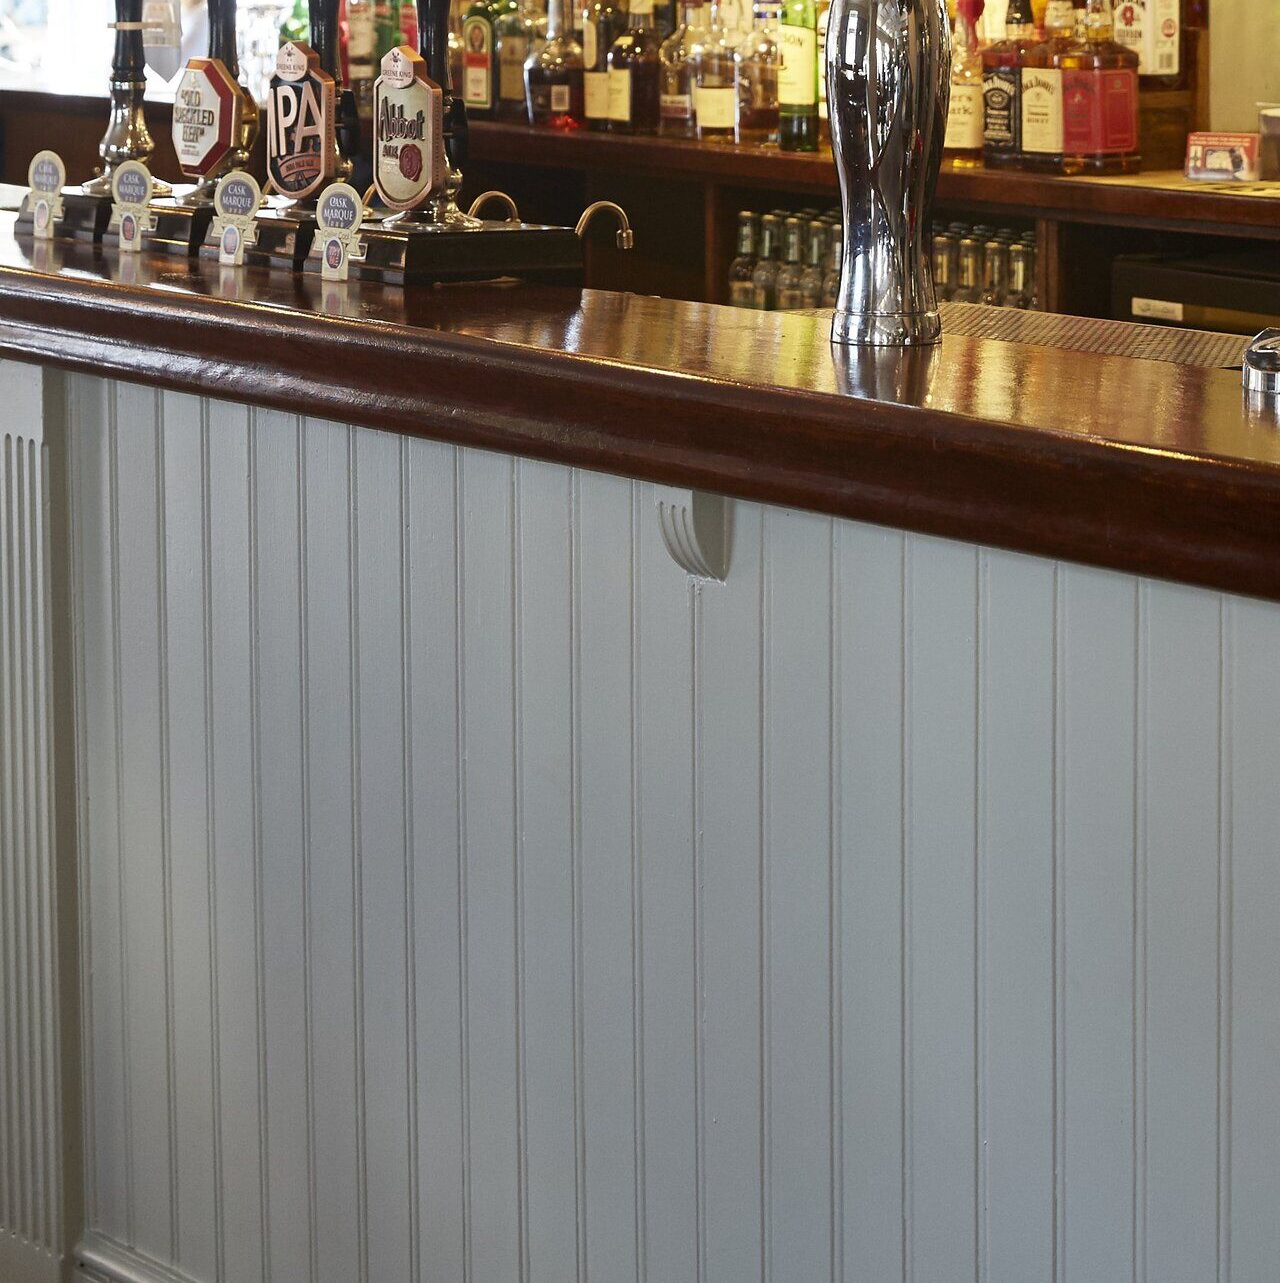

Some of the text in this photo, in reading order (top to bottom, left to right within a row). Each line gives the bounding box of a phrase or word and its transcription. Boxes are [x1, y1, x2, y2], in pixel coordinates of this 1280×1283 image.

[292, 63, 305, 72] KING
[382, 69, 412, 78] GREENE KING
[269, 80, 321, 158] IPA
[379, 96, 426, 143] Abbot
[123, 174, 139, 184] CASK
[119, 184, 145, 196] MARQUE
[228, 184, 246, 195] CASK
[222, 195, 251, 208] MARQUE
[329, 197, 348, 208] CASK
[323, 208, 353, 221] MARQUE
